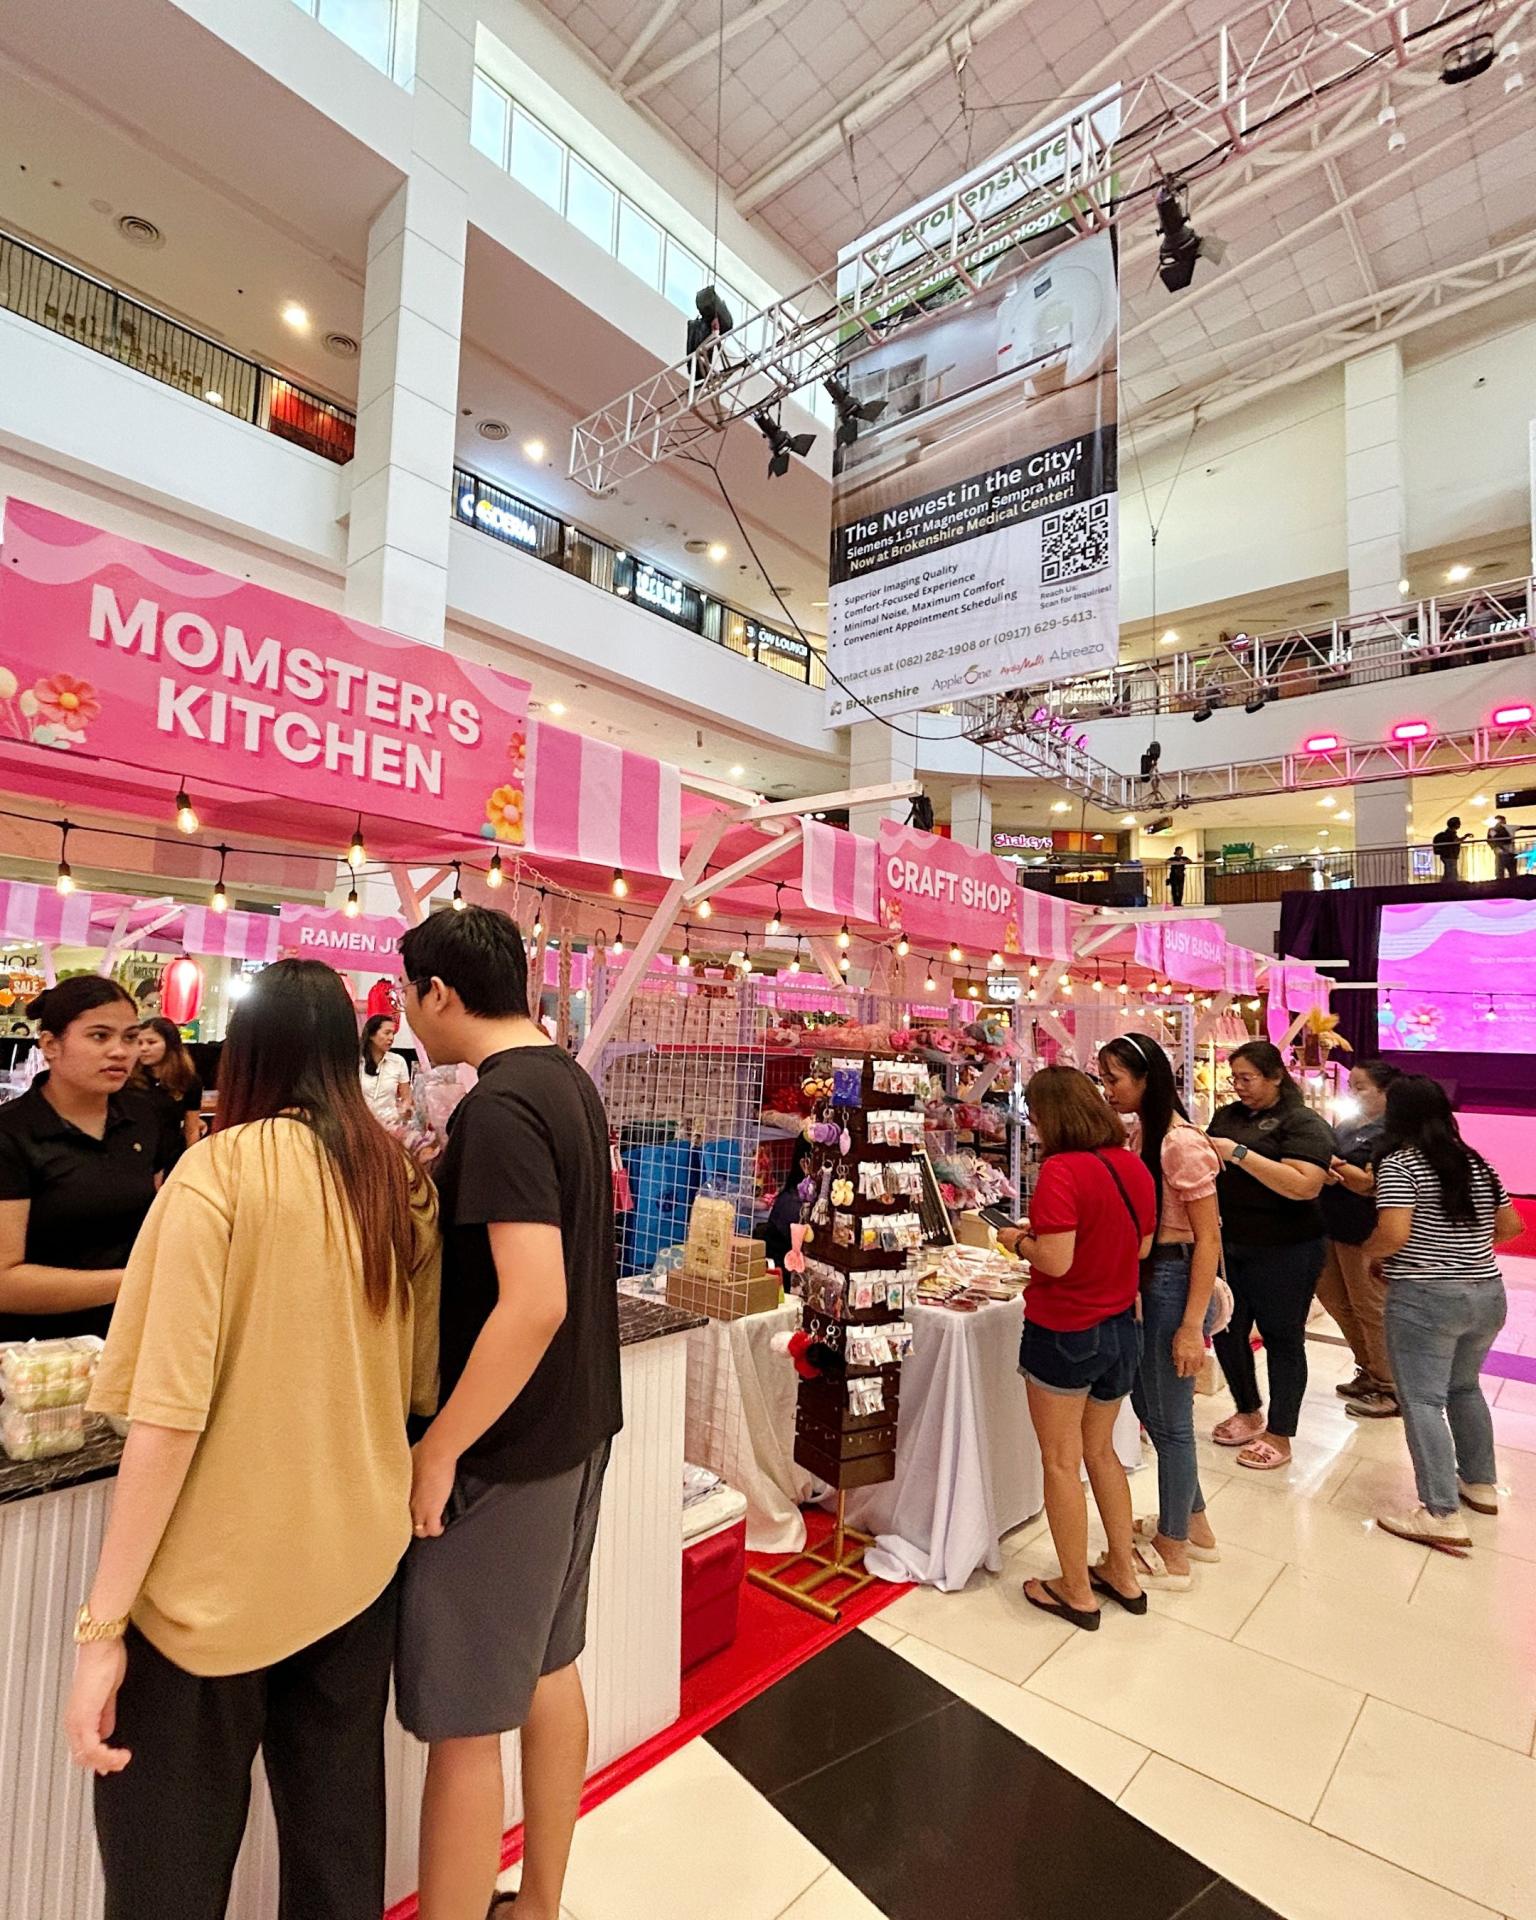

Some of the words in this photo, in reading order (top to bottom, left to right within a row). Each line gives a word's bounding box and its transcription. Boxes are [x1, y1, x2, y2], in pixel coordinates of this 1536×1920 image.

[845, 521, 879, 544] The
[883, 490, 956, 531] Newest
[961, 483, 980, 503] in
[985, 470, 1022, 493] the
[1028, 441, 1082, 477] City!
[846, 536, 893, 560] Siemens
[896, 525, 920, 542] 1.5T
[922, 502, 989, 533] Magnetom
[992, 482, 1044, 509] Sempra
[1047, 469, 1075, 489] MRI
[850, 556, 875, 572] Now
[877, 550, 889, 562] at
[891, 525, 964, 557] Brokenshire
[966, 505, 1018, 532] Medical
[1021, 485, 1074, 513] Center!
[844, 587, 881, 606] Superior
[884, 574, 920, 593] Imaging
[922, 564, 958, 582] Quality
[844, 591, 920, 620] Comfort-Focused
[922, 573, 976, 597] Experience
[844, 615, 879, 633] Minimal
[881, 607, 909, 622] Noise,
[912, 592, 960, 613] Maximum
[963, 577, 1005, 598] Comfort
[1039, 597, 1059, 610] Scan
[1060, 594, 1072, 606] for
[1040, 586, 1064, 600] Reach
[843, 627, 893, 647] Convenient
[895, 608, 958, 632] Appointment
[960, 590, 1018, 613] Scheduling
[870, 666, 882, 677] us
[883, 662, 894, 674] at
[896, 653, 923, 671] (082)
[925, 641, 976, 662] 282-1908
[979, 637, 992, 648] or
[994, 625, 1031, 645] (0917)
[1034, 610, 1097, 633] 629-5413.
[89, 583, 481, 746] MOMSTER'S
[846, 686, 920, 711] Brokenshire
[157, 677, 442, 795] KITCHEN
[993, 832, 1053, 850] Shakey's
[887, 856, 959, 902] CRAFT
[961, 876, 1011, 914] SHOP
[300, 926, 376, 952] RAMEN
[1165, 928, 1190, 955] BUSY
[14, 979, 40, 994] SALE
